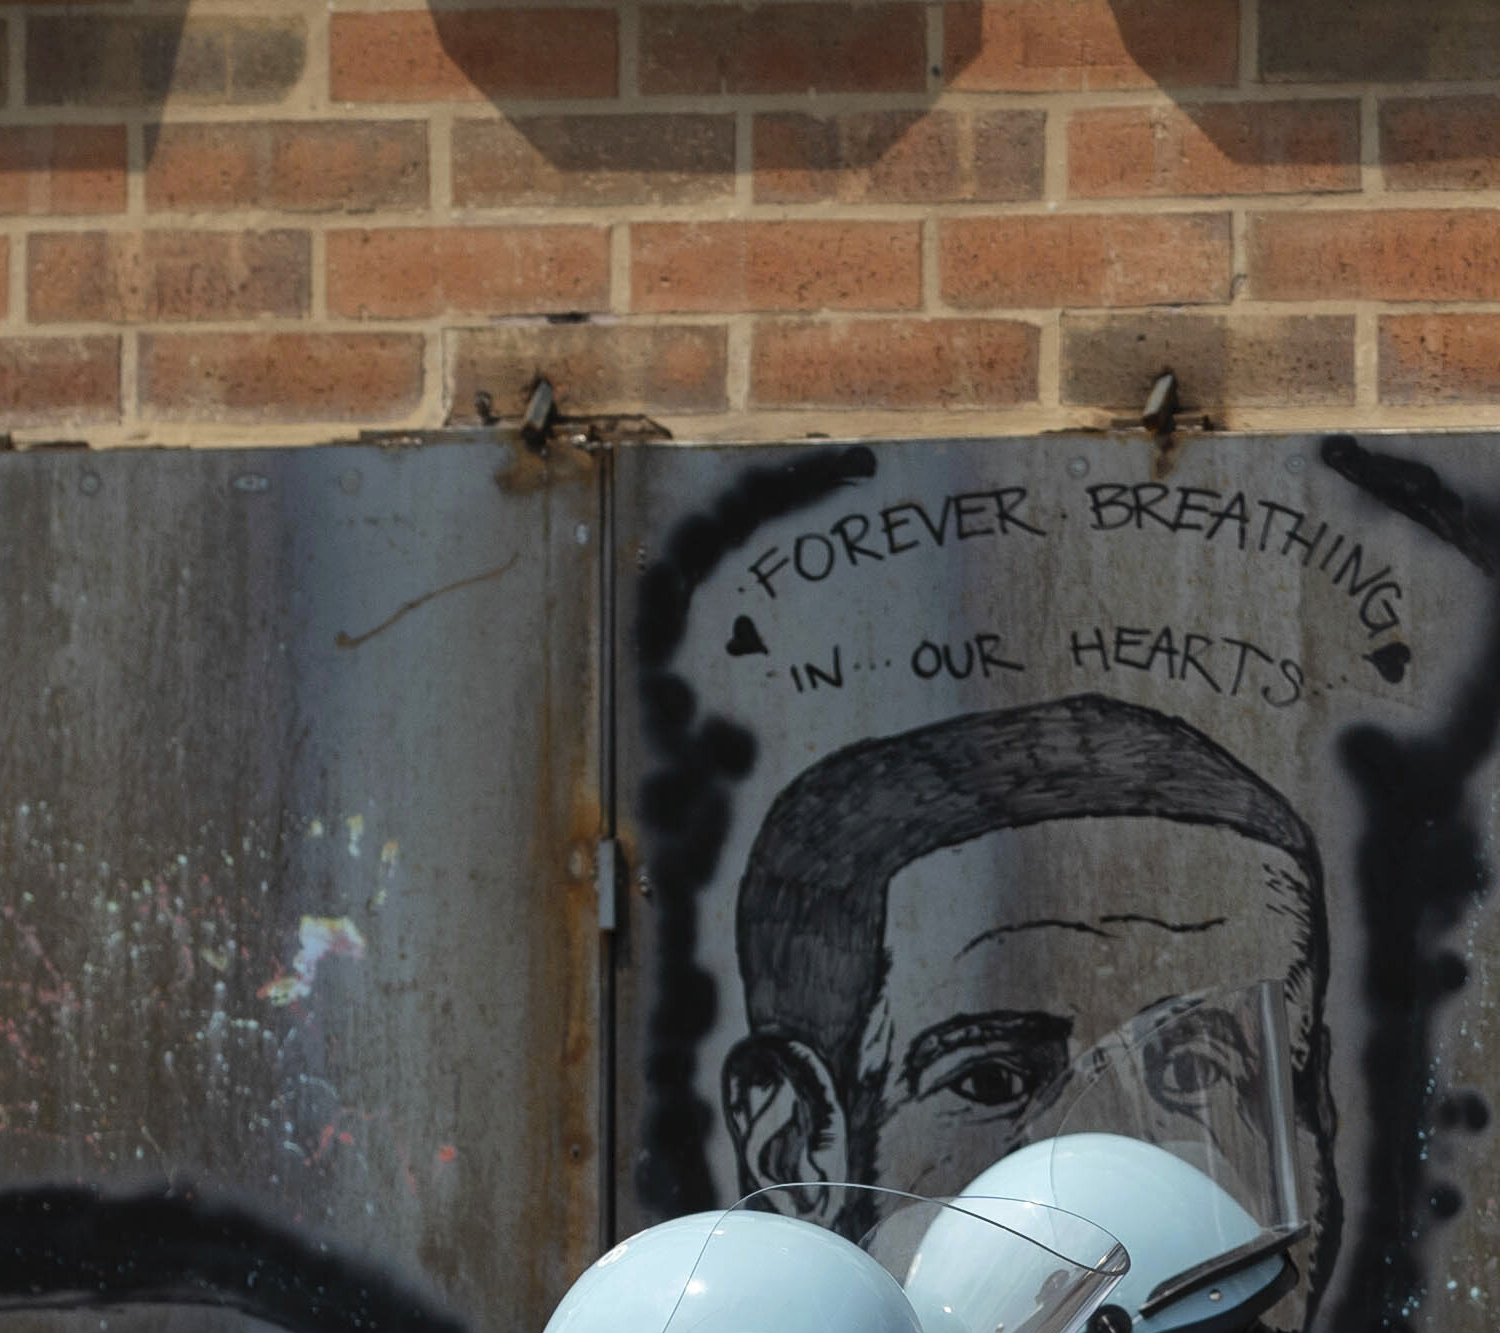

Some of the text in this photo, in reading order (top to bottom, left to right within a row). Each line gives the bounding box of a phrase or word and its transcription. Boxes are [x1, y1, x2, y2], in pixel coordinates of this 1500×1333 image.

[748, 482, 1404, 640] FOREVER BREATHING
[910, 634, 1025, 680] OUR
